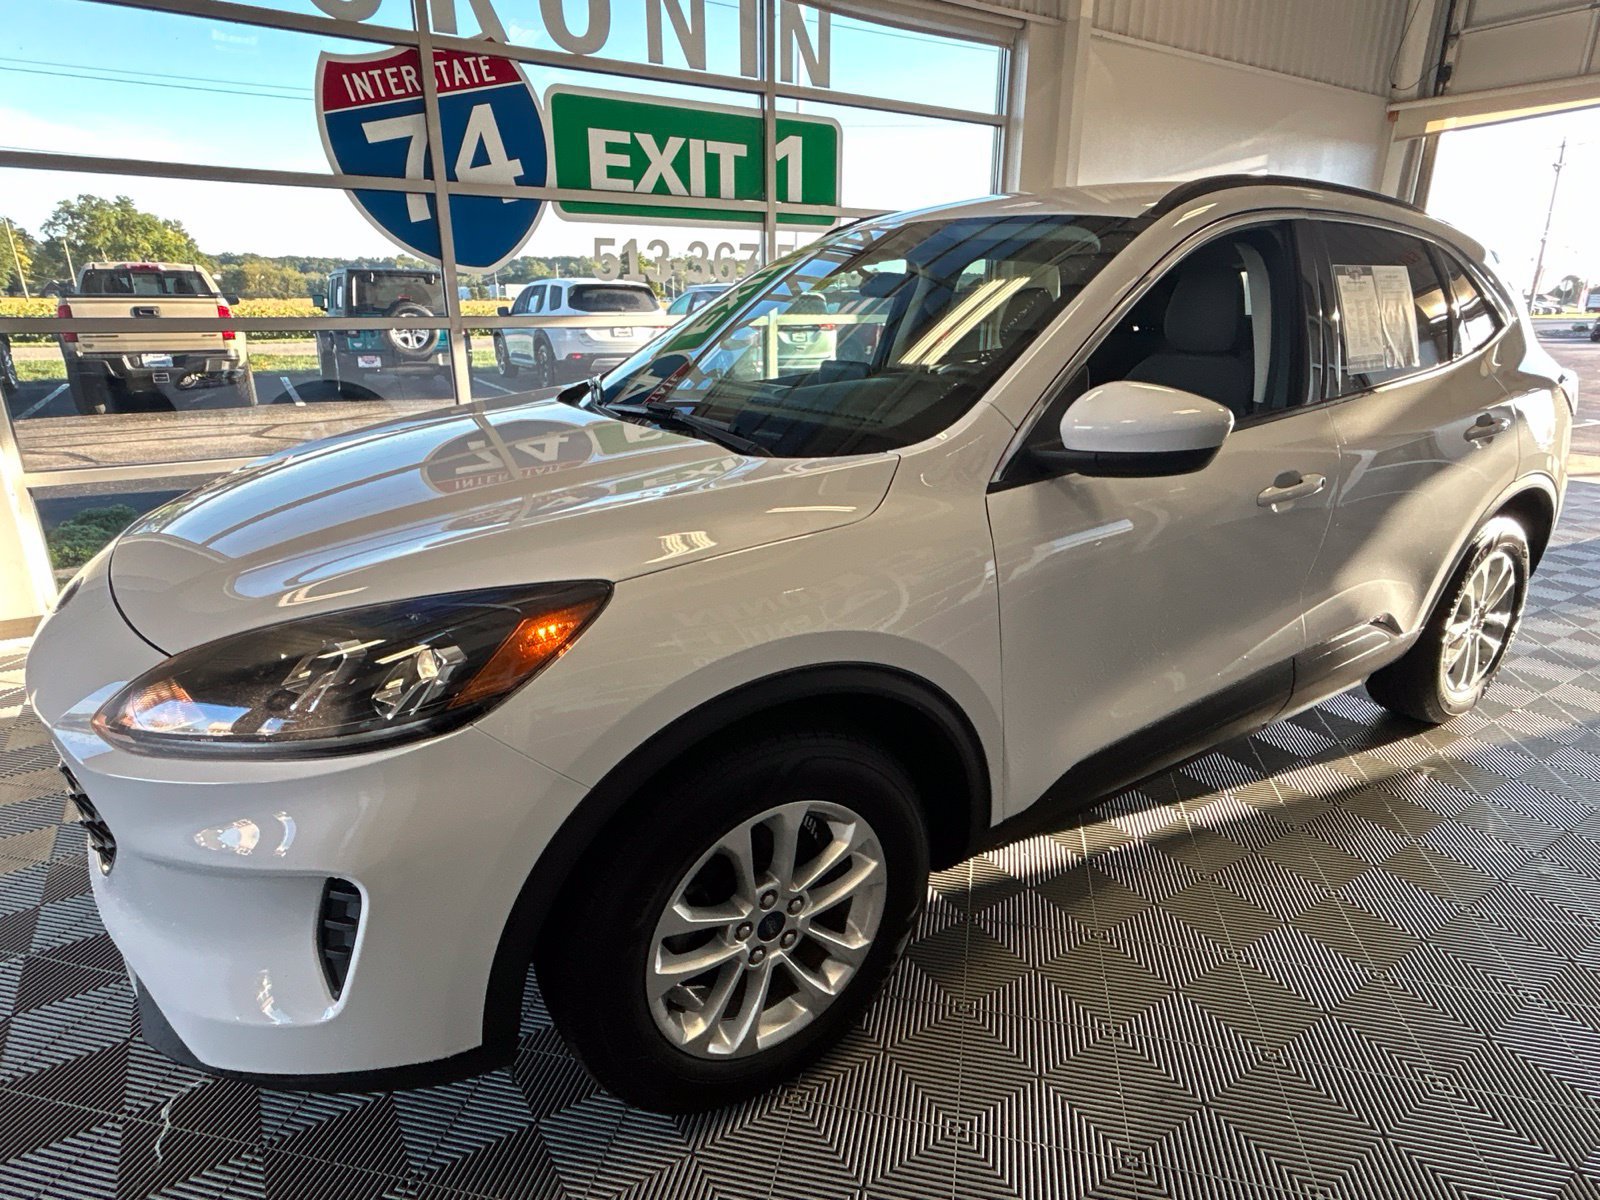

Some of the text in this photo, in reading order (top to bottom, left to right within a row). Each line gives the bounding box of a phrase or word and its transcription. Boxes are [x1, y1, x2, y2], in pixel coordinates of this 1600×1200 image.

[342, 55, 496, 102] INTERTATE
[361, 103, 524, 223] 74
[588, 128, 803, 202] EXIT 1
